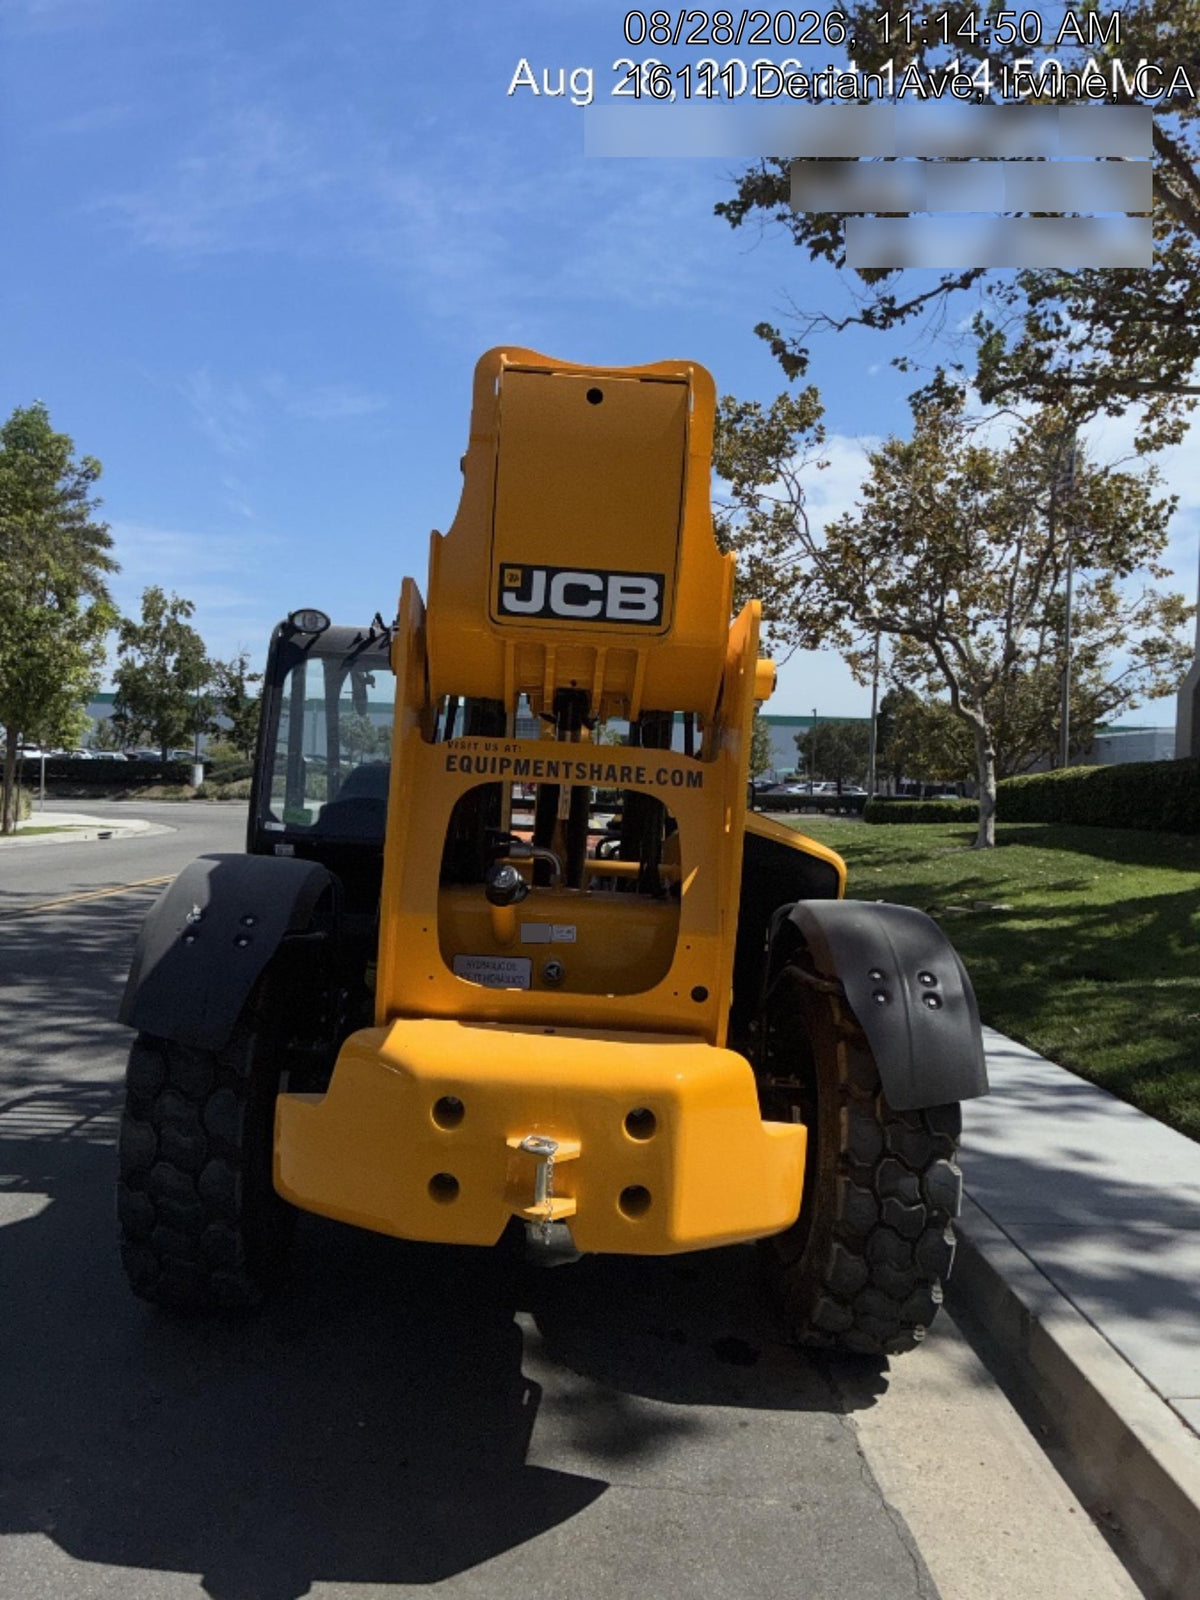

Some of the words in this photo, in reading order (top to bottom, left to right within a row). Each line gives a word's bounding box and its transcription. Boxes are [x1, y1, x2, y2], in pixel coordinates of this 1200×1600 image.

[502, 569, 659, 622] JCB
[447, 740, 478, 751] VISIT
[484, 742, 499, 753] US
[445, 754, 704, 788] EQUIPMENTSHARE.COM
